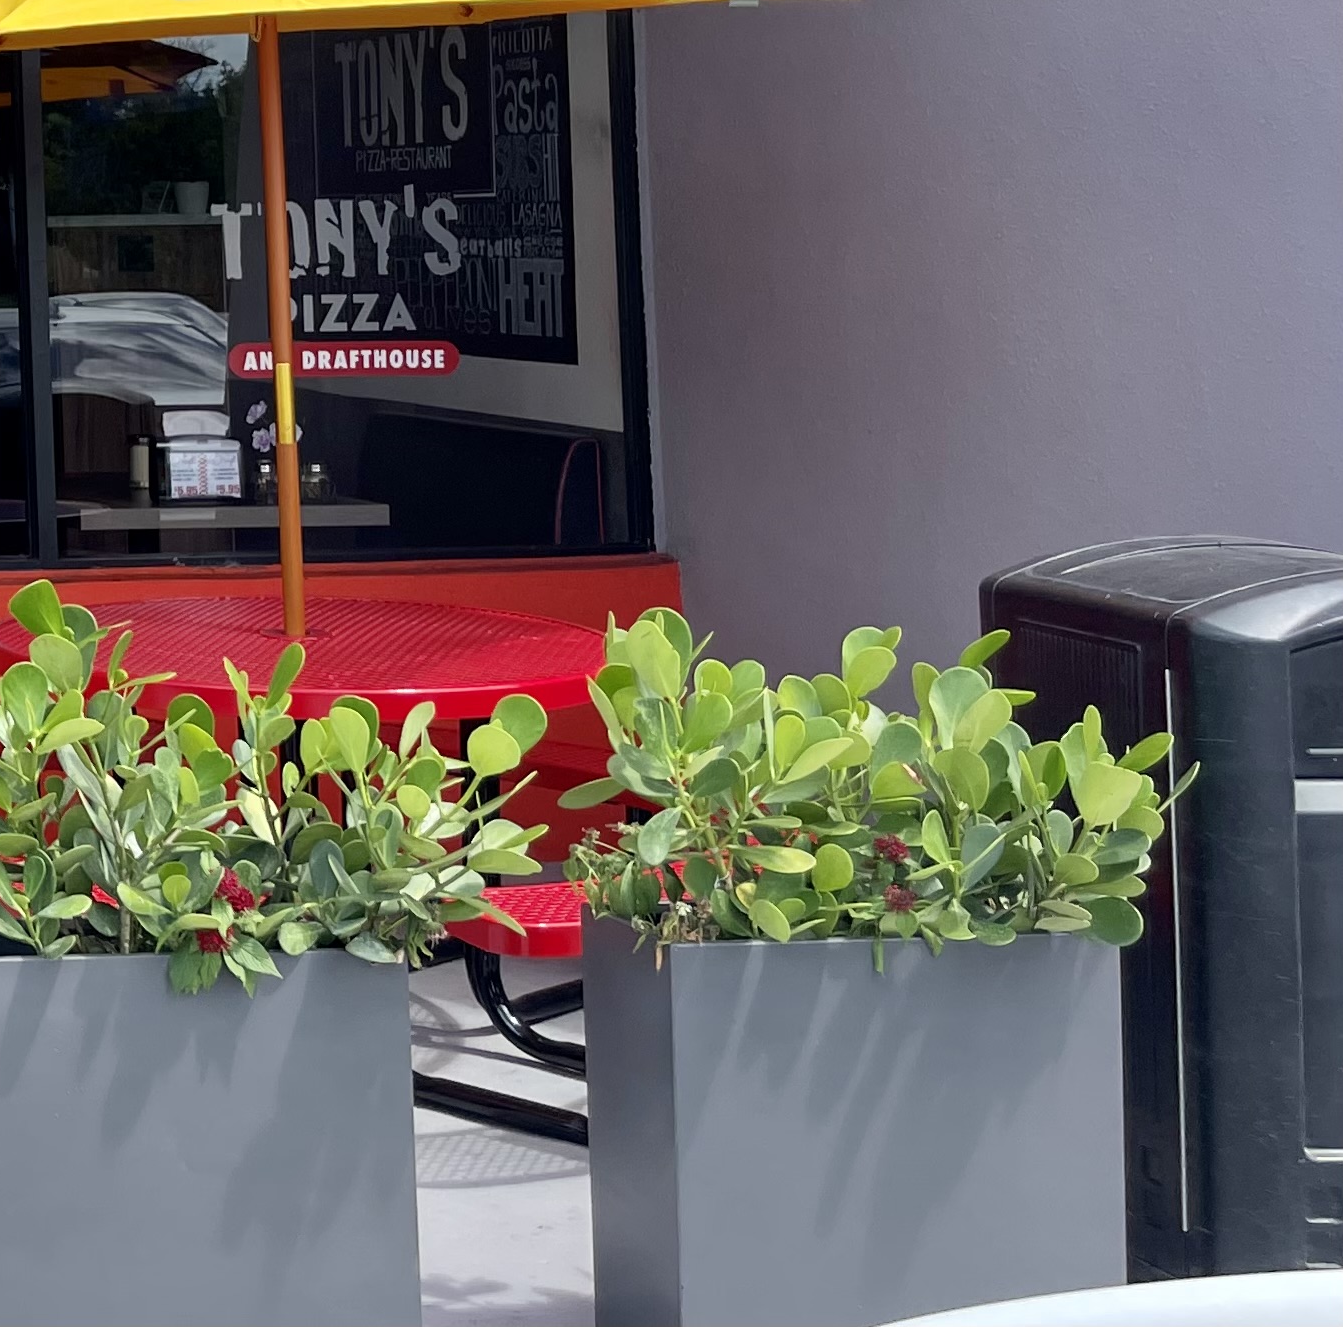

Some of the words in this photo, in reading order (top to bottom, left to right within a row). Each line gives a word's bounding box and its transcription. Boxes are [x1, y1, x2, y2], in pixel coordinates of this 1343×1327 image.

[334, 26, 469, 148] TONY'S
[494, 58, 559, 135] Pasta
[210, 183, 461, 280] TONY'S
[460, 237, 522, 258] eatballs
[289, 292, 417, 333] IZZA
[243, 351, 273, 371] AN
[302, 349, 445, 371] DRAFTHOUSE
